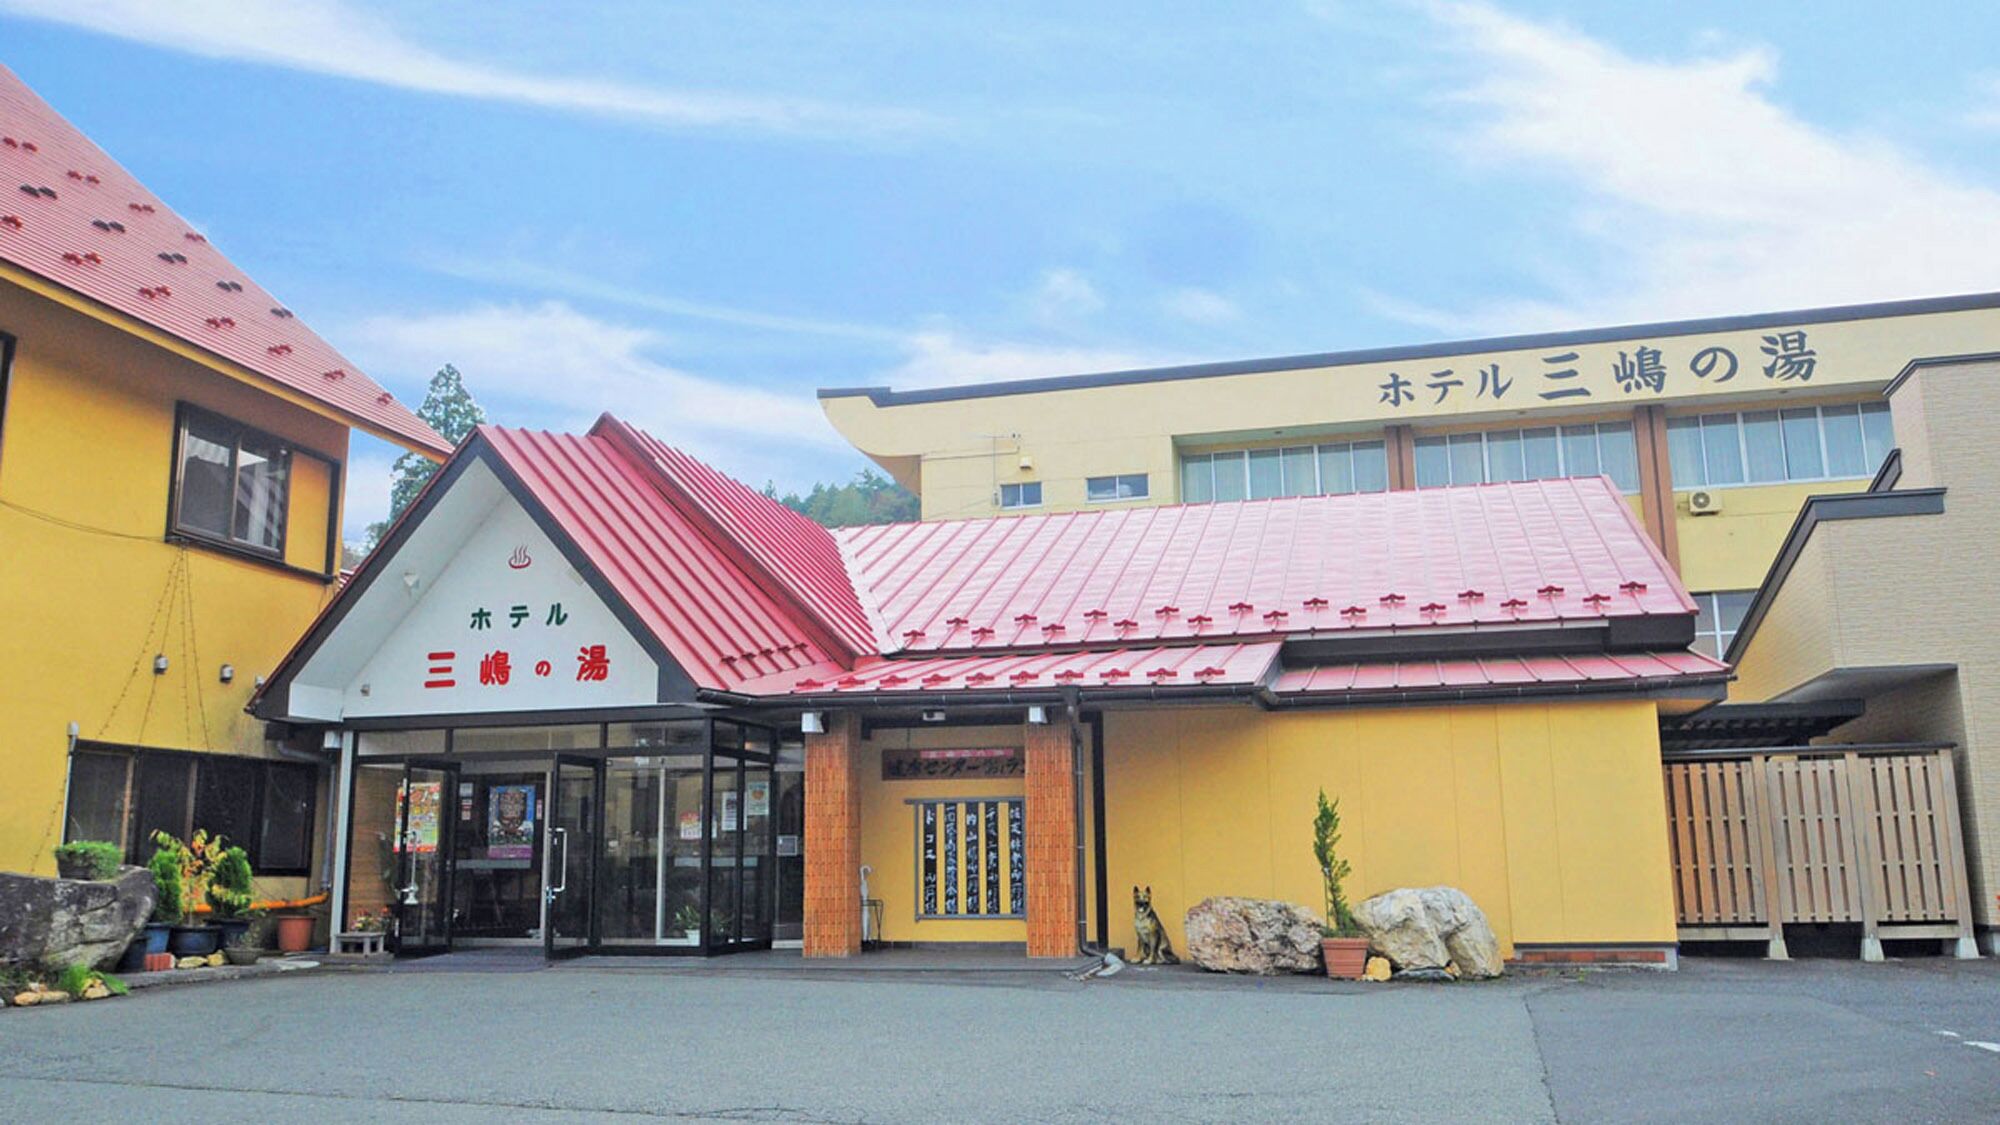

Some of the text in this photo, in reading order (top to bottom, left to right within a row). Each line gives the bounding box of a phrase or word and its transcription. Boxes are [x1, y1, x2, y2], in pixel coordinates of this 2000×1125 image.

[1378, 330, 1818, 407] ホテル三嶋の湯
[470, 602, 568, 630] ホテル
[424, 644, 610, 688] 三嶋の湯
